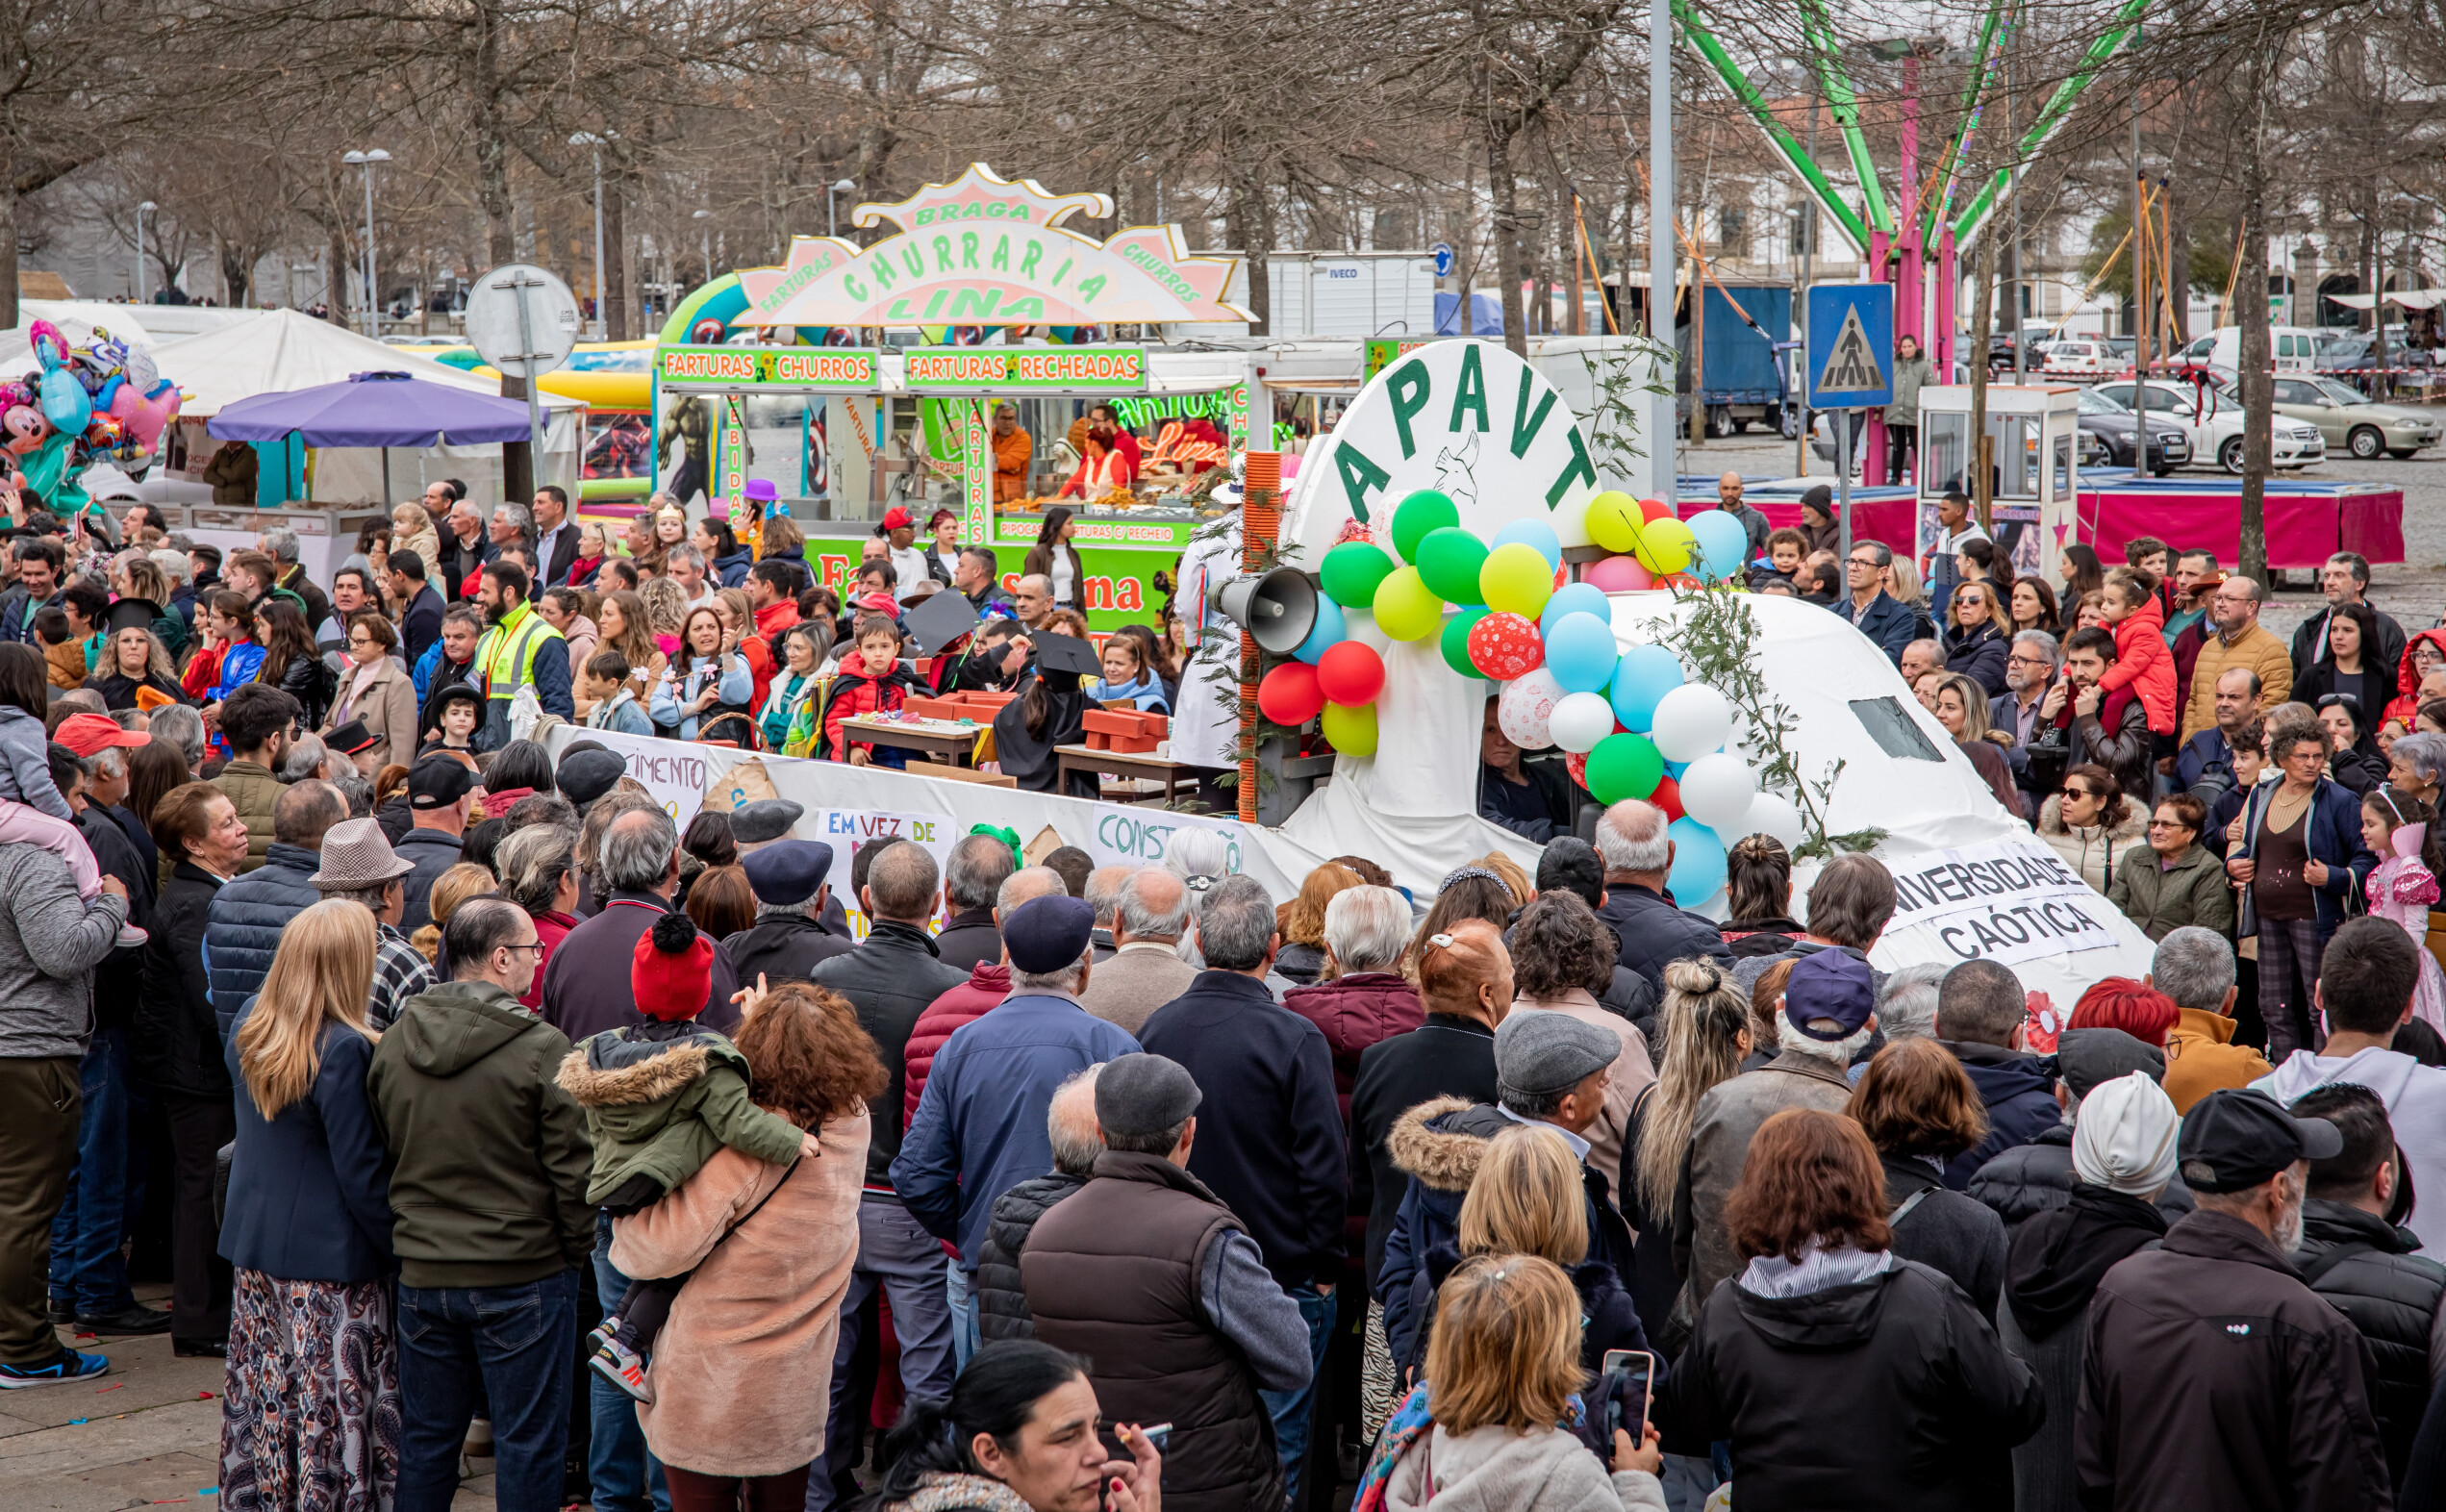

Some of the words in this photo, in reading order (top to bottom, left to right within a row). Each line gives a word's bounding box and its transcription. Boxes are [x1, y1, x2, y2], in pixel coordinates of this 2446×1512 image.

[916, 201, 1030, 226] BRAGA
[759, 251, 833, 314] FARTURAS
[844, 231, 1107, 304] CHURRARIA
[1122, 242, 1201, 304] CHURROS
[1329, 268, 1358, 279] IVECO
[886, 288, 1044, 320] LINA
[666, 354, 754, 377] FARTURAS
[778, 357, 870, 381] CHURROS
[909, 357, 1006, 380] FARTURAS
[1020, 356, 1139, 380] RECHEADAS
[1333, 343, 1598, 525] APAVT
[1128, 528, 1172, 540] RECHEIO
[828, 812, 855, 835] EM
[860, 815, 901, 838] VEZ
[913, 821, 935, 842] DE
[1939, 902, 2105, 959] CAÓTICA
